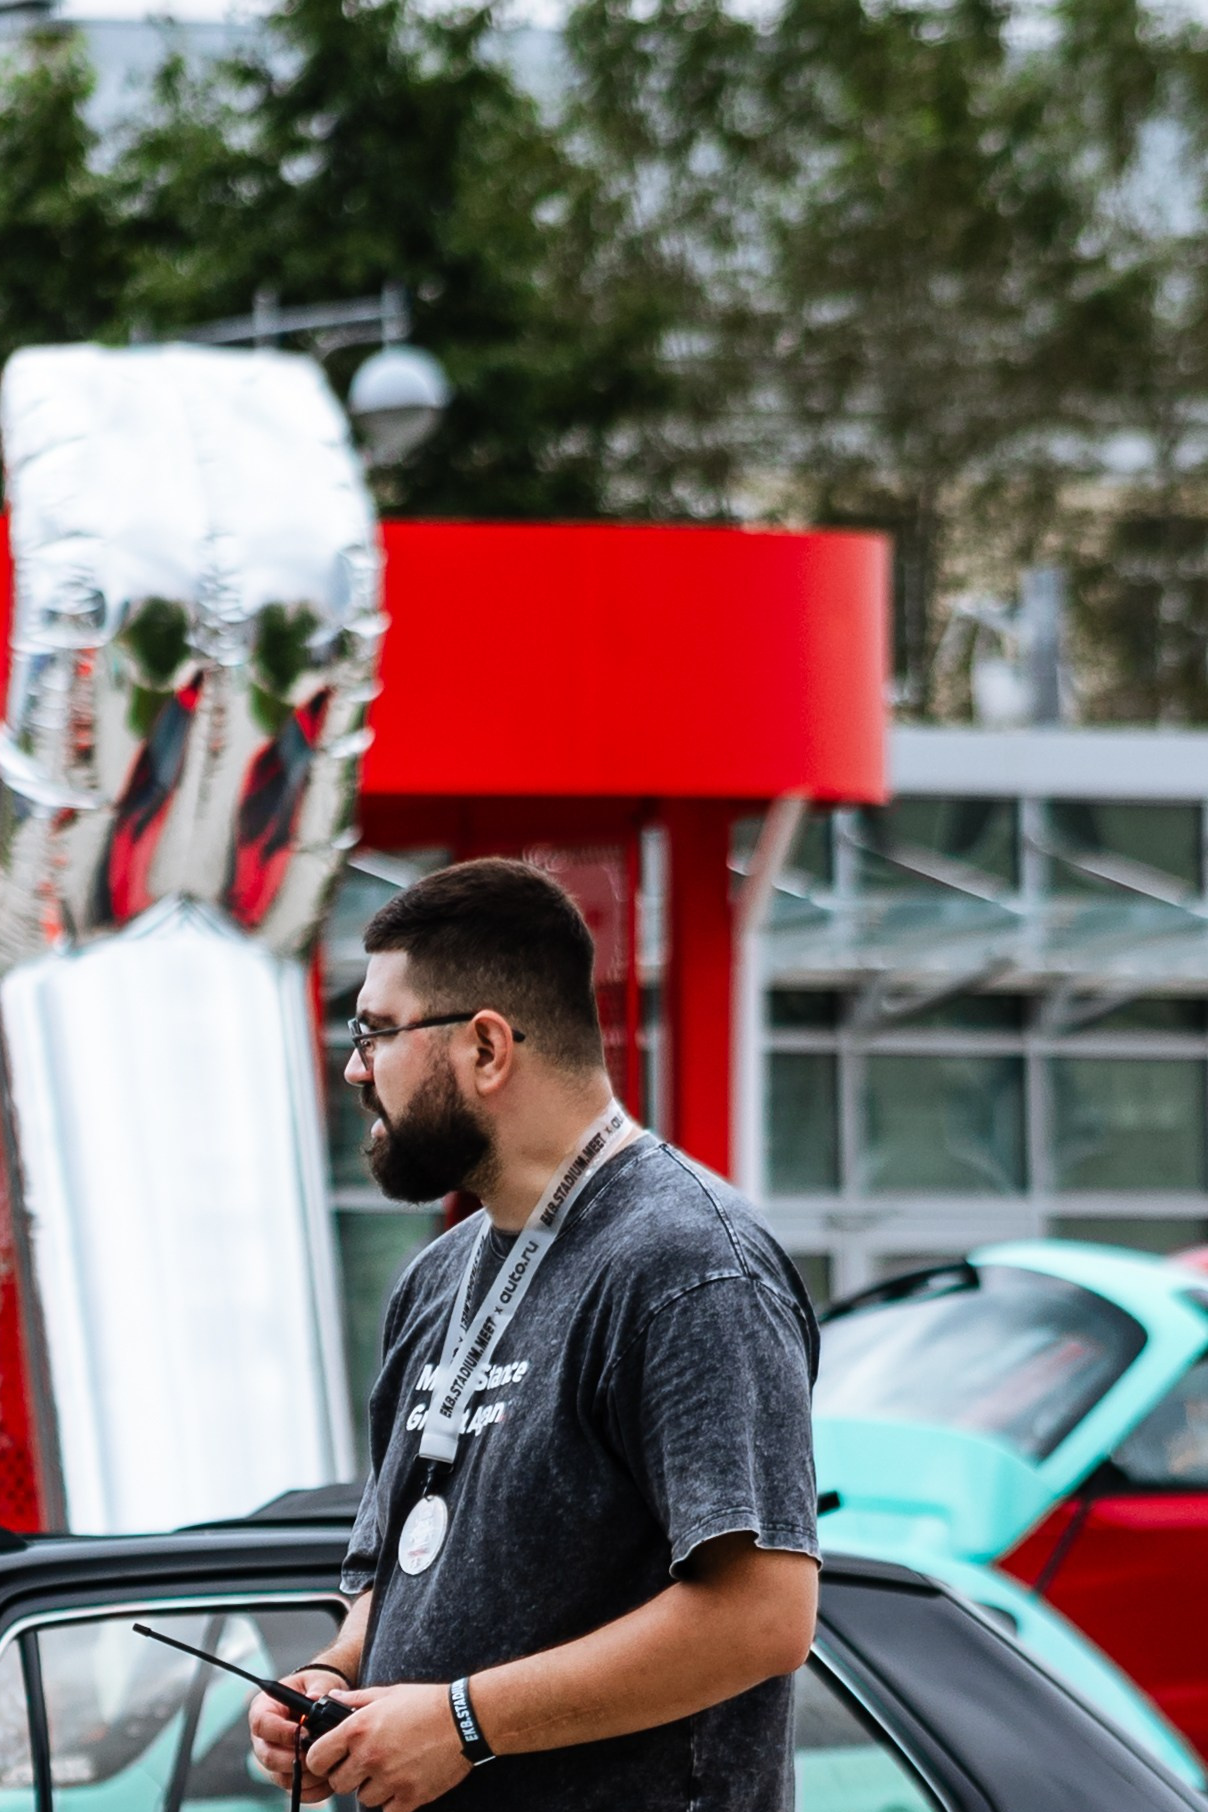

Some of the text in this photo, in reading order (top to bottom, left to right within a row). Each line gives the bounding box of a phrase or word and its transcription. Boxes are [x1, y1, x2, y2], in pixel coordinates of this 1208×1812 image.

[540, 1131, 607, 1228] EKB.STADIUM.MEET
[439, 1315, 497, 1419] EKB.STADIUM.MEET
[500, 1240, 540, 1305] auto.ru
